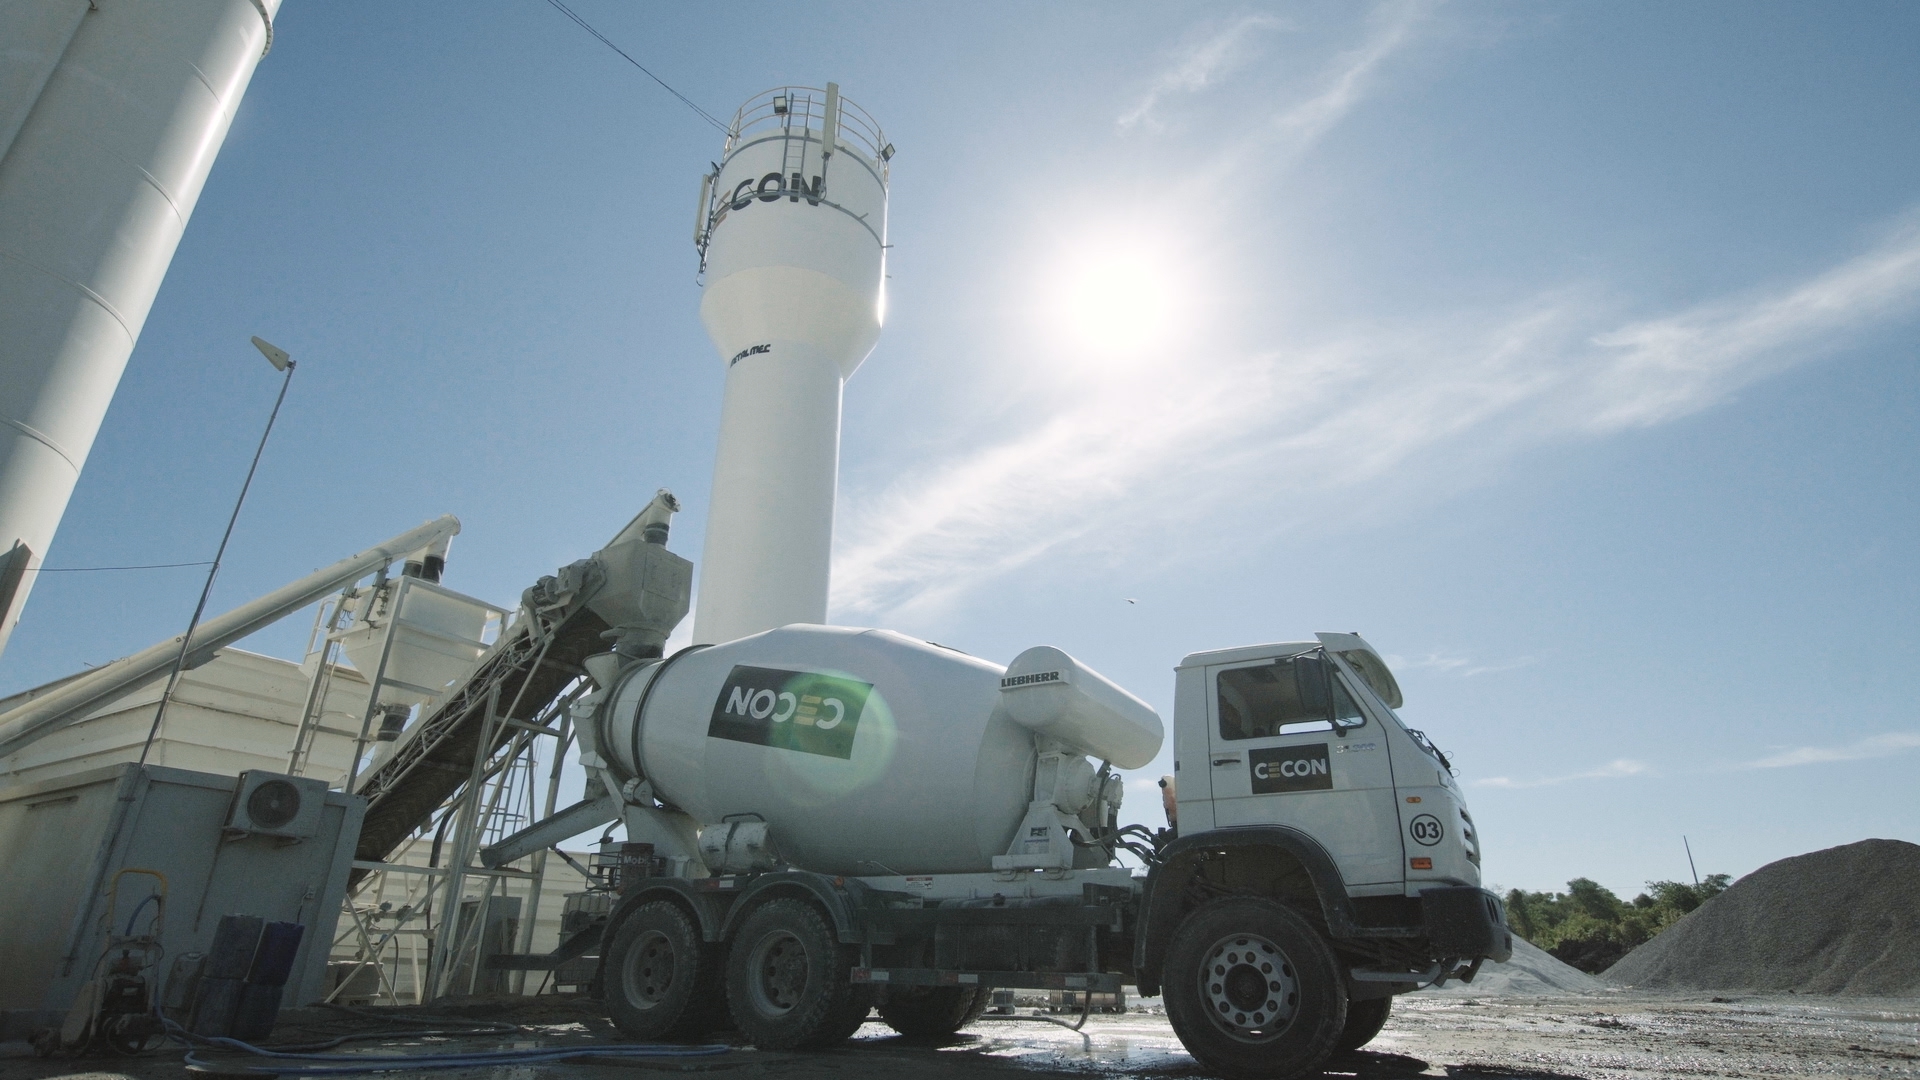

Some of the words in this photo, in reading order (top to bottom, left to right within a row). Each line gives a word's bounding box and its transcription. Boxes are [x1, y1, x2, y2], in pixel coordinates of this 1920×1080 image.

[1001, 671, 1060, 688] LIEBHERR
[725, 686, 845, 730] CECON
[1254, 758, 1327, 779] CECON
[1414, 821, 1440, 839] 03
